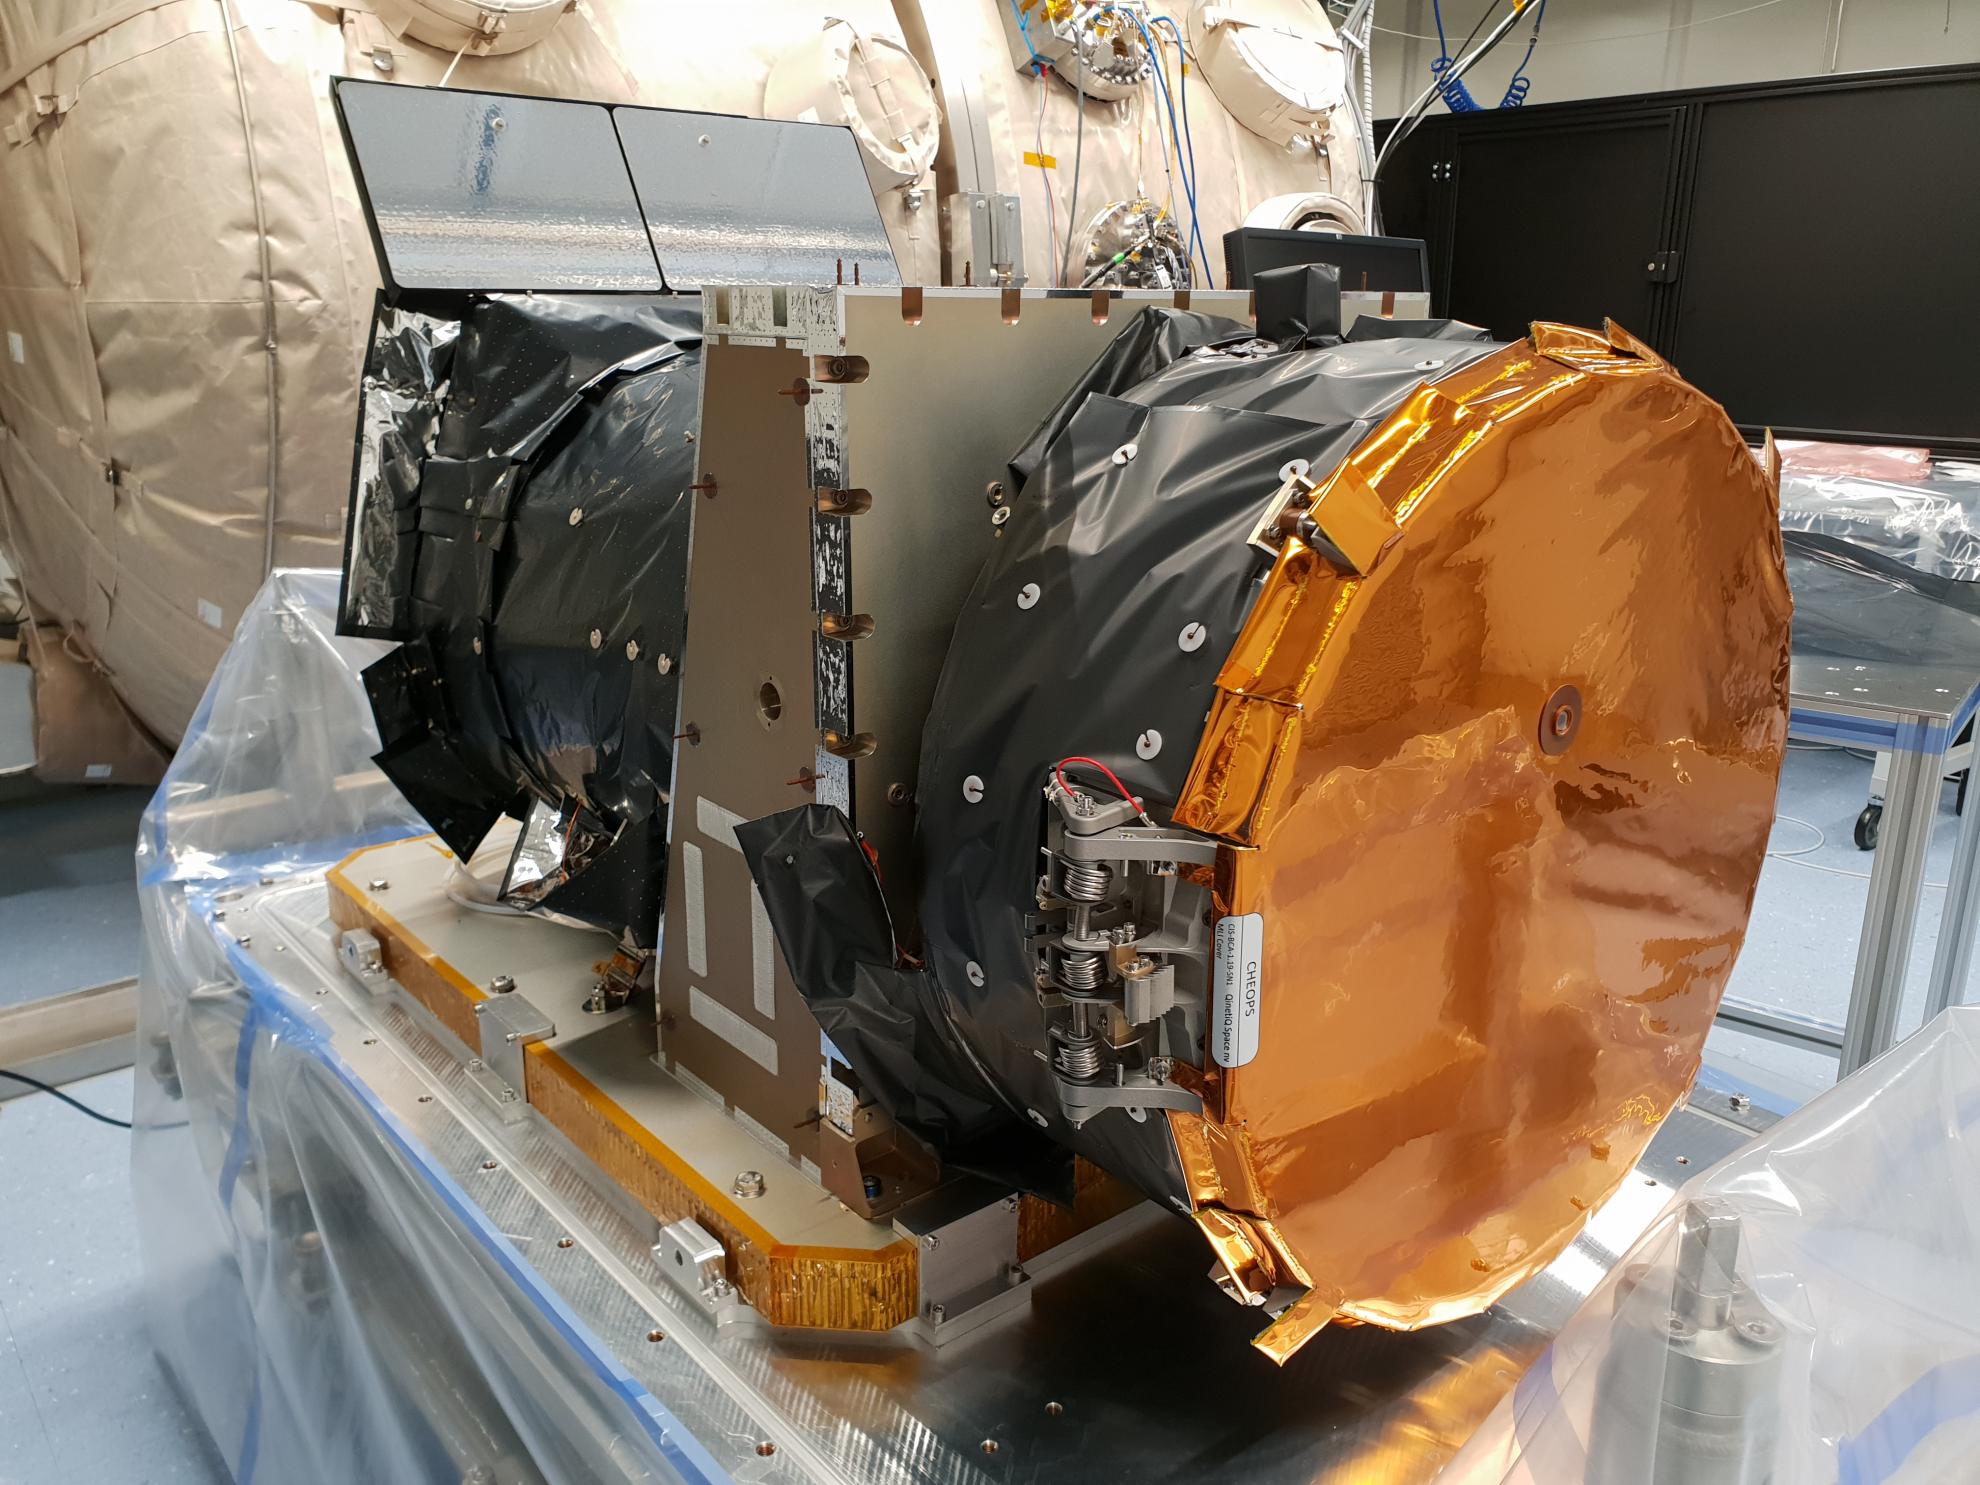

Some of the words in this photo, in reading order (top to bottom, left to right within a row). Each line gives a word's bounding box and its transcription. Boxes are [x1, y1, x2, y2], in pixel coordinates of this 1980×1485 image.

[1216, 938, 1224, 959] Cover
[1226, 923, 1236, 986] CIS-BCA-1.19-SN1
[1245, 961, 1257, 1016] CHEOPS
[1224, 994, 1233, 1026] QinetiQ
[1222, 1027, 1232, 1051] Space
[1223, 1052, 1230, 1063] nv
